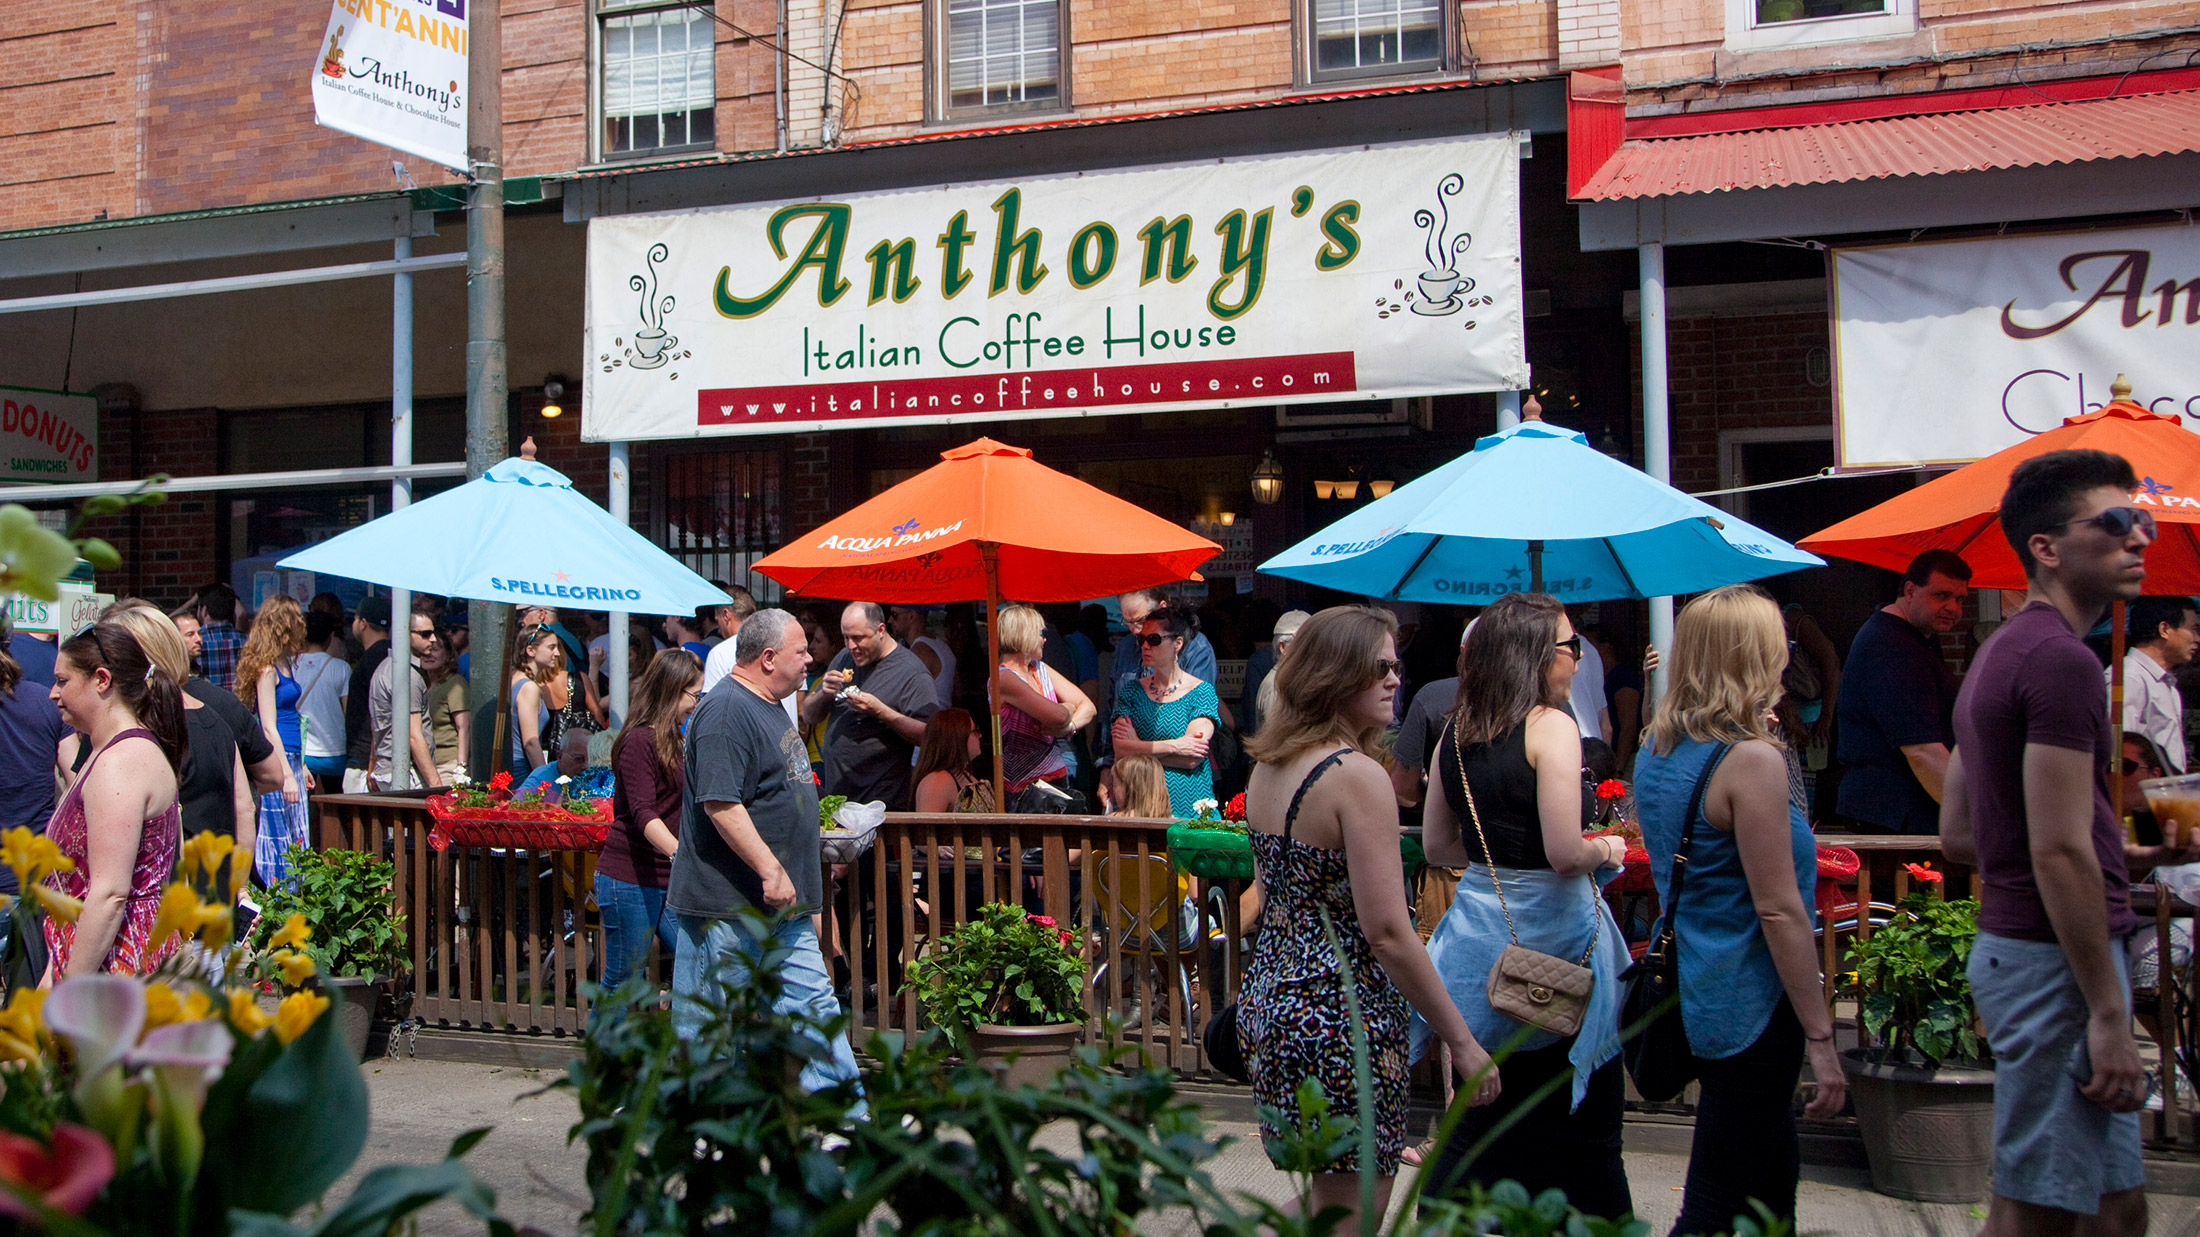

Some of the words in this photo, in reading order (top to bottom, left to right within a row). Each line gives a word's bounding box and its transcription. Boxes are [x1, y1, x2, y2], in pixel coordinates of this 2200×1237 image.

[322, 77, 346, 91] Italian
[347, 85, 371, 100] Coffee
[372, 93, 395, 108] House
[396, 101, 403, 110] &
[404, 103, 439, 122] Chocolate
[440, 115, 461, 129] House
[349, 57, 461, 113] Anthony's
[712, 186, 1361, 321] Anthony's
[804, 323, 921, 377] Italian
[938, 311, 1086, 369] Coffee
[1103, 303, 1237, 360] House
[720, 370, 1331, 417] www.italiancoffeehouse.com
[3, 399, 94, 472] DONUTS
[11, 457, 68, 473] SANDWICHES
[817, 535, 891, 552] ACQUA
[894, 519, 966, 547] PANNA
[491, 576, 641, 601] S.PELLEGRINO
[71, 599, 99, 631] Gelat
